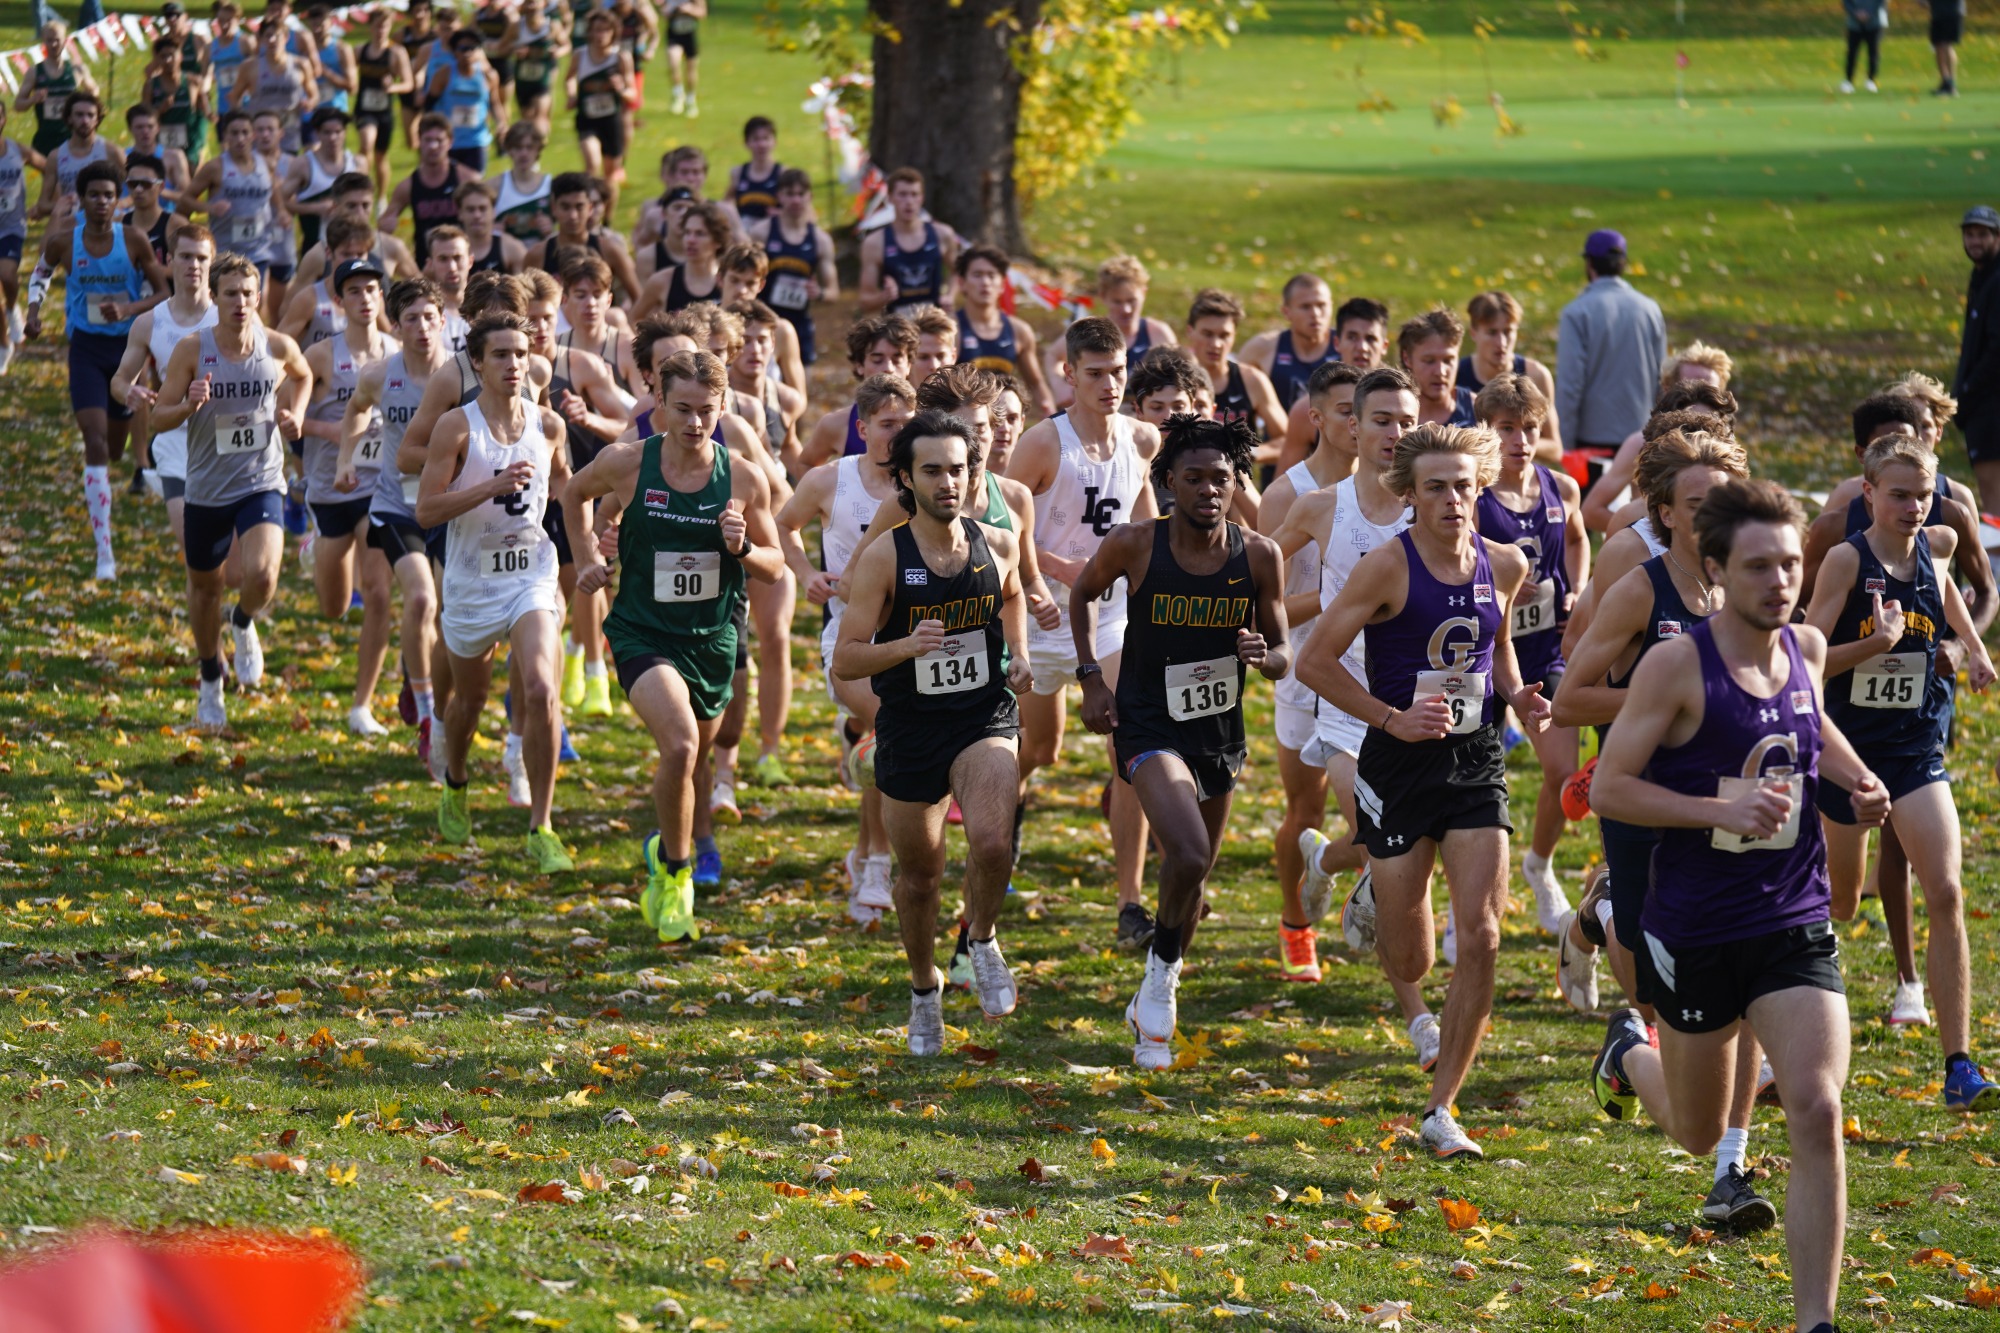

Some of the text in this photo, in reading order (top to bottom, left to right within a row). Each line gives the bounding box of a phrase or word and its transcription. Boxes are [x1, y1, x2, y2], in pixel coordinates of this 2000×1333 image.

[231, 428, 254, 449] 48
[361, 441, 381, 460] 47
[648, 510, 717, 525] evergreen
[492, 548, 529, 573] 106
[673, 573, 702, 596] 90
[1152, 594, 1249, 627] NOMAH
[1516, 605, 1540, 630] 19
[1427, 616, 1480, 674] G
[930, 656, 978, 688] 134
[1181, 681, 1228, 713] 136
[1865, 677, 1914, 702] 145
